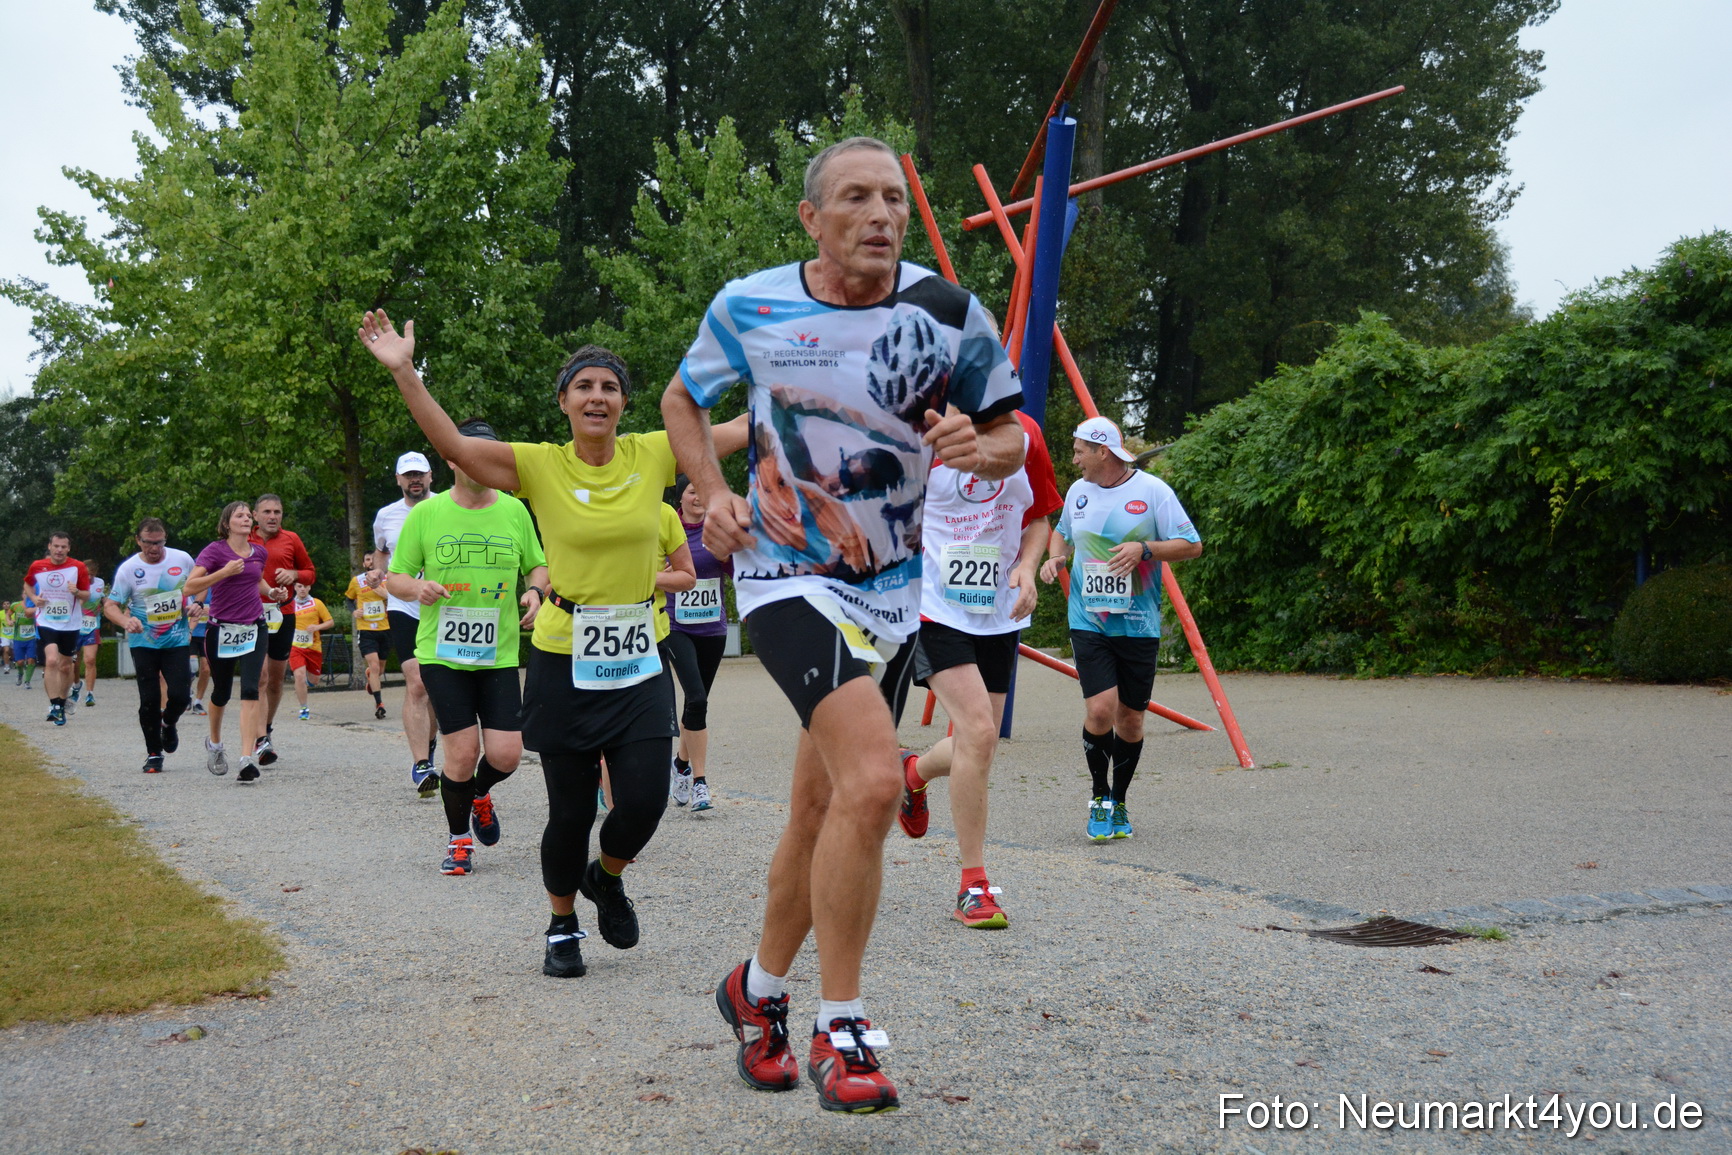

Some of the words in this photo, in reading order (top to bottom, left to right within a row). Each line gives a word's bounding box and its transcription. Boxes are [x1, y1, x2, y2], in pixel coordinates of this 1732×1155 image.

[774, 350, 846, 358] REGENSBURGER
[769, 360, 816, 368] TRIATHLON
[944, 514, 979, 524] LAUFEN
[435, 533, 514, 565] OPF
[948, 559, 999, 588] 2226
[1086, 574, 1127, 594] 3086
[680, 589, 718, 607] 2204
[959, 592, 995, 606] Rüdiger
[46, 606, 68, 615] 2455
[153, 599, 177, 614] 254
[223, 629, 255, 645] 2435
[444, 620, 495, 644] 2920
[583, 623, 650, 657] 2545
[457, 648, 481, 658] Klaus
[595, 663, 640, 678] Cornelia
